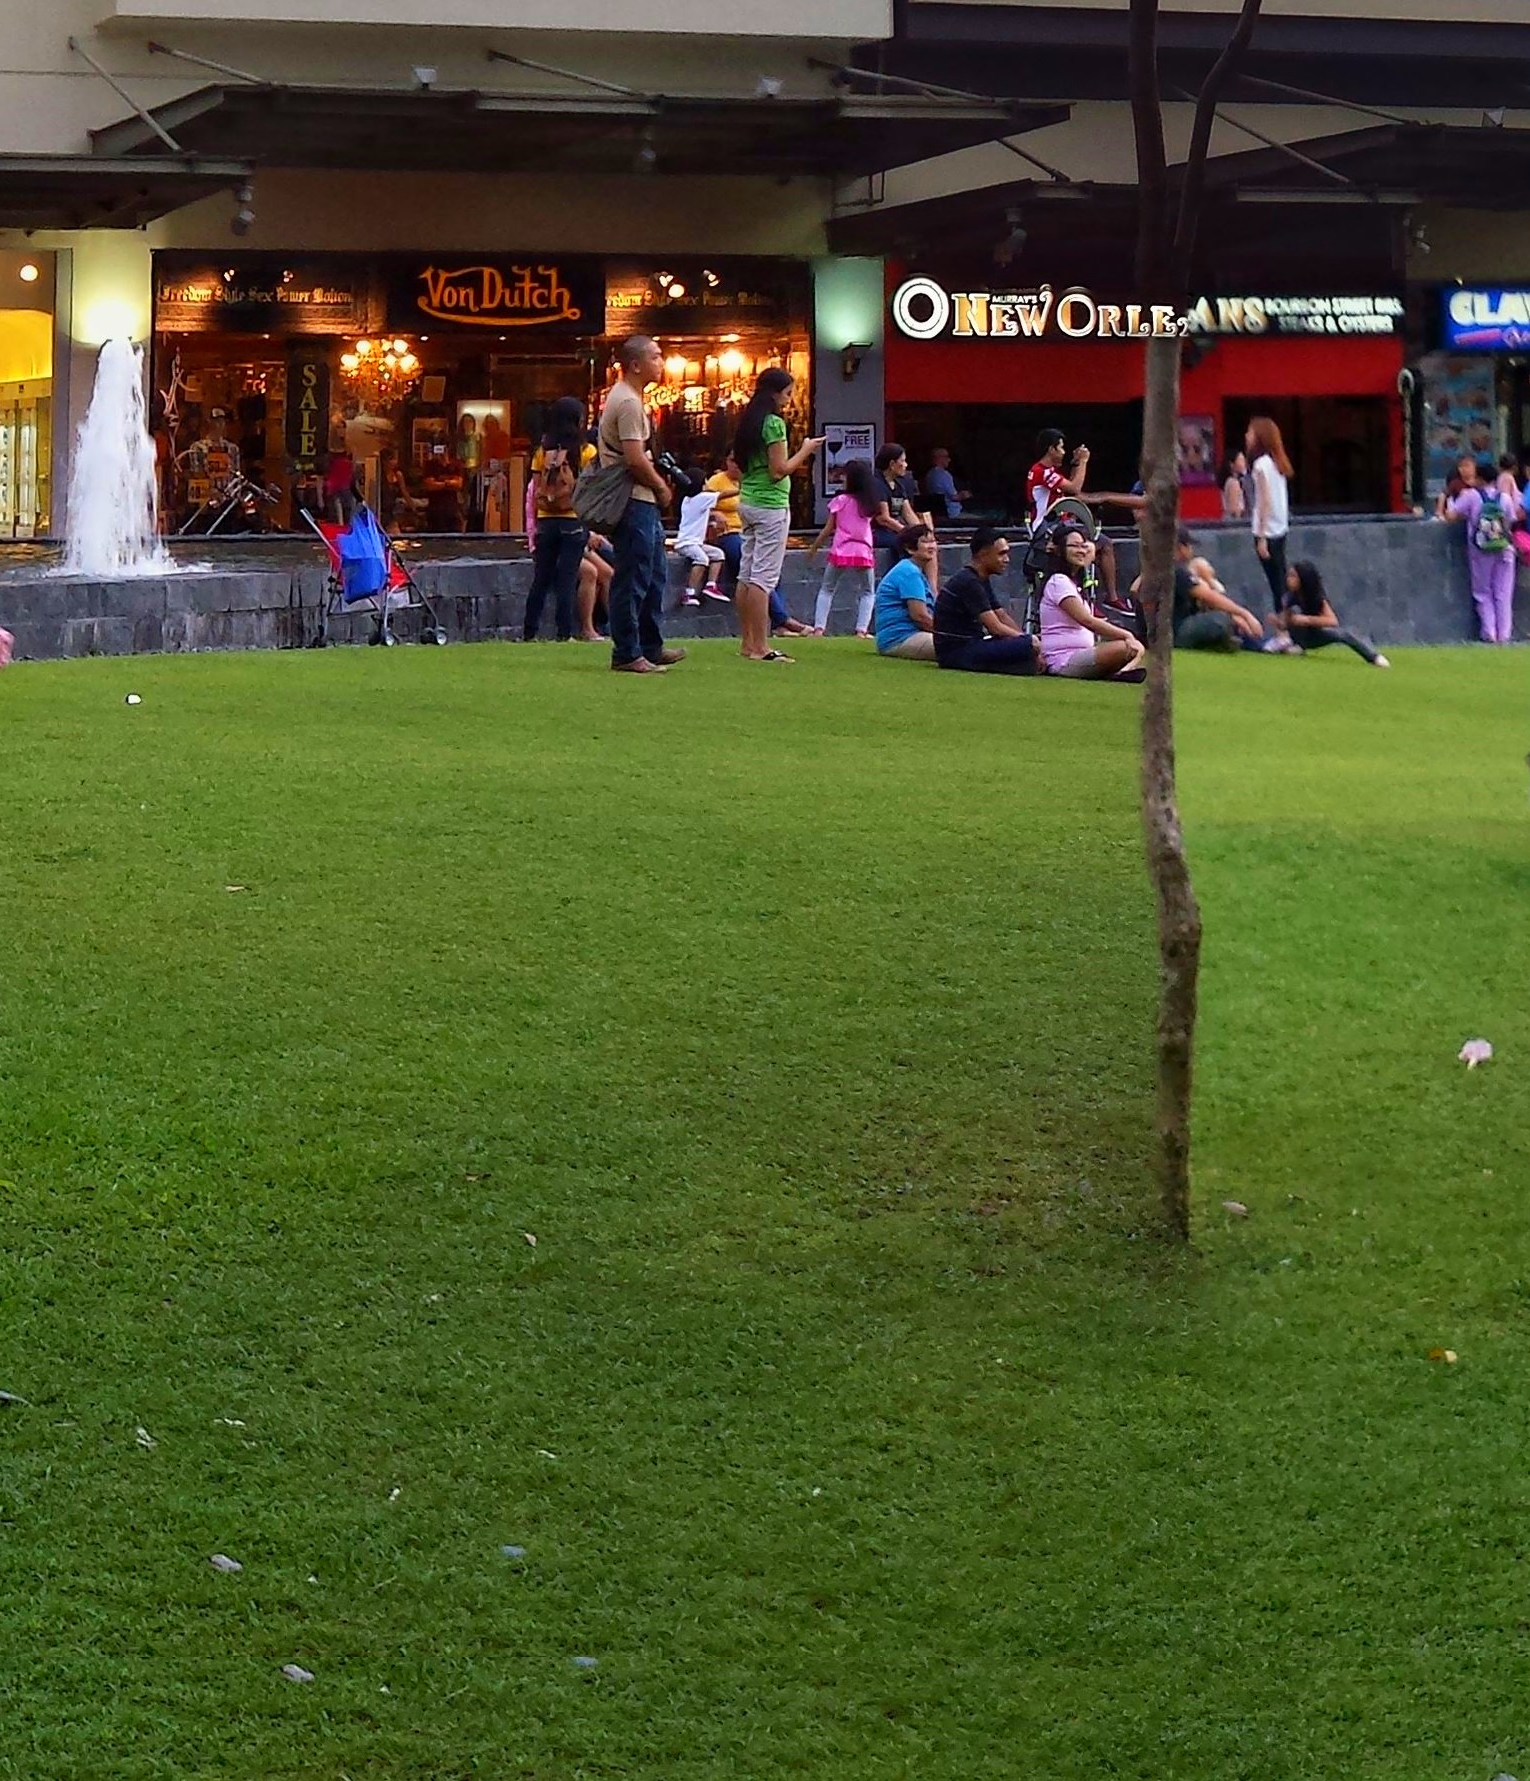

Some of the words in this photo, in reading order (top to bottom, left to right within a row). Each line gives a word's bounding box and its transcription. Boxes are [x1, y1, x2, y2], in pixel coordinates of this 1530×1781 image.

[479, 265, 573, 312] Dutch
[299, 364, 318, 456] SALE
[845, 435, 870, 446] FREE
